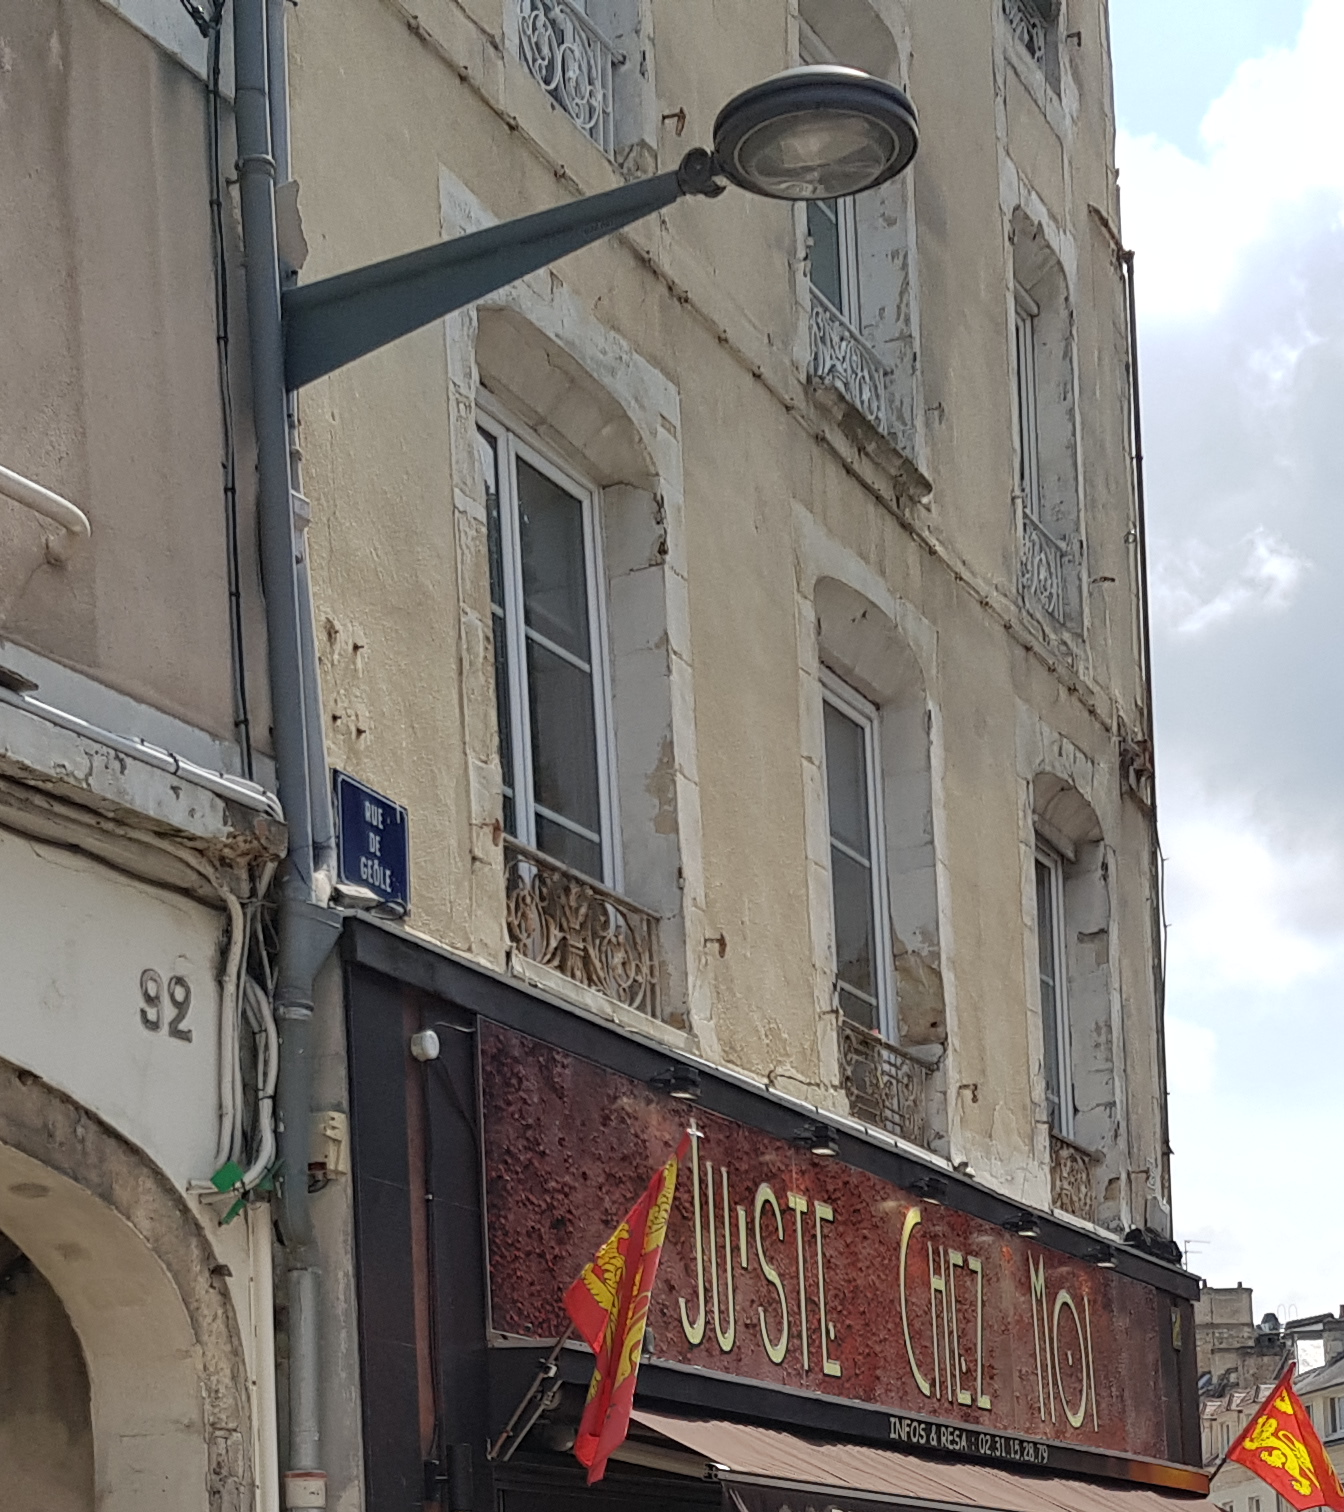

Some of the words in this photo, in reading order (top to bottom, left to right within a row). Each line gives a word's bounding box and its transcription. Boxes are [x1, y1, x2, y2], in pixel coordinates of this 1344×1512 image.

[365, 801, 384, 829] RUE
[368, 831, 382, 857] DE
[139, 968, 193, 1043] 92
[1028, 1250, 1100, 1433] MOI
[889, 1417, 927, 1444] INFOS
[930, 1425, 938, 1447] &
[940, 1426, 968, 1452] RESA
